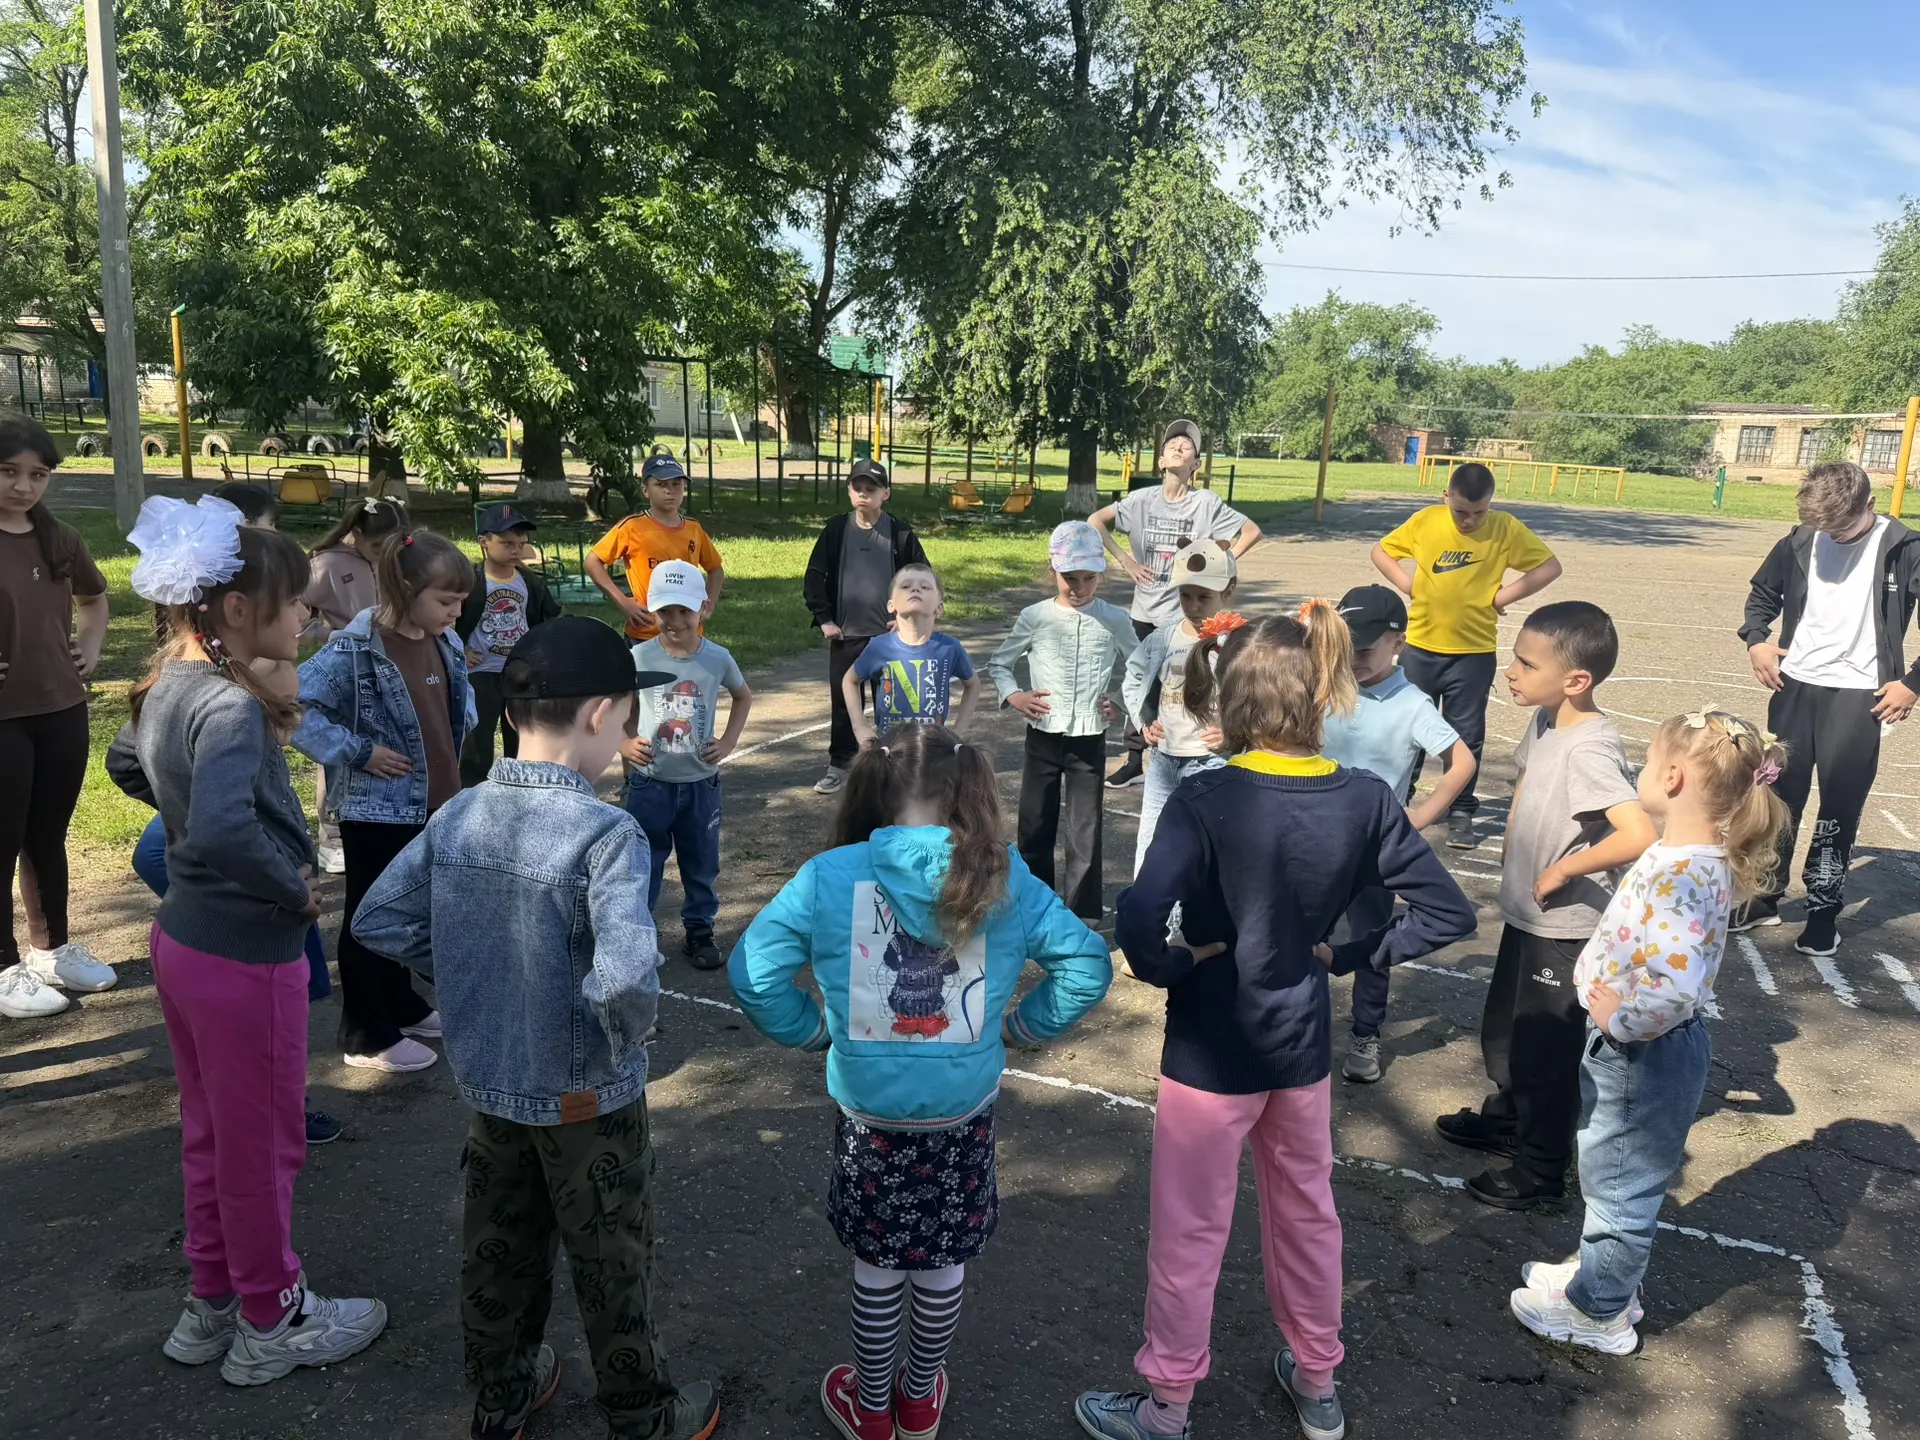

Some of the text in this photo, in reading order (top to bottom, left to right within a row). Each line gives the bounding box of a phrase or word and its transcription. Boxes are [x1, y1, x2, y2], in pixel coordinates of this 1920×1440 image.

[1438, 550, 1473, 563] NIKE
[698, 704, 706, 721] PAW
[1532, 974, 1561, 987] GENUINE
